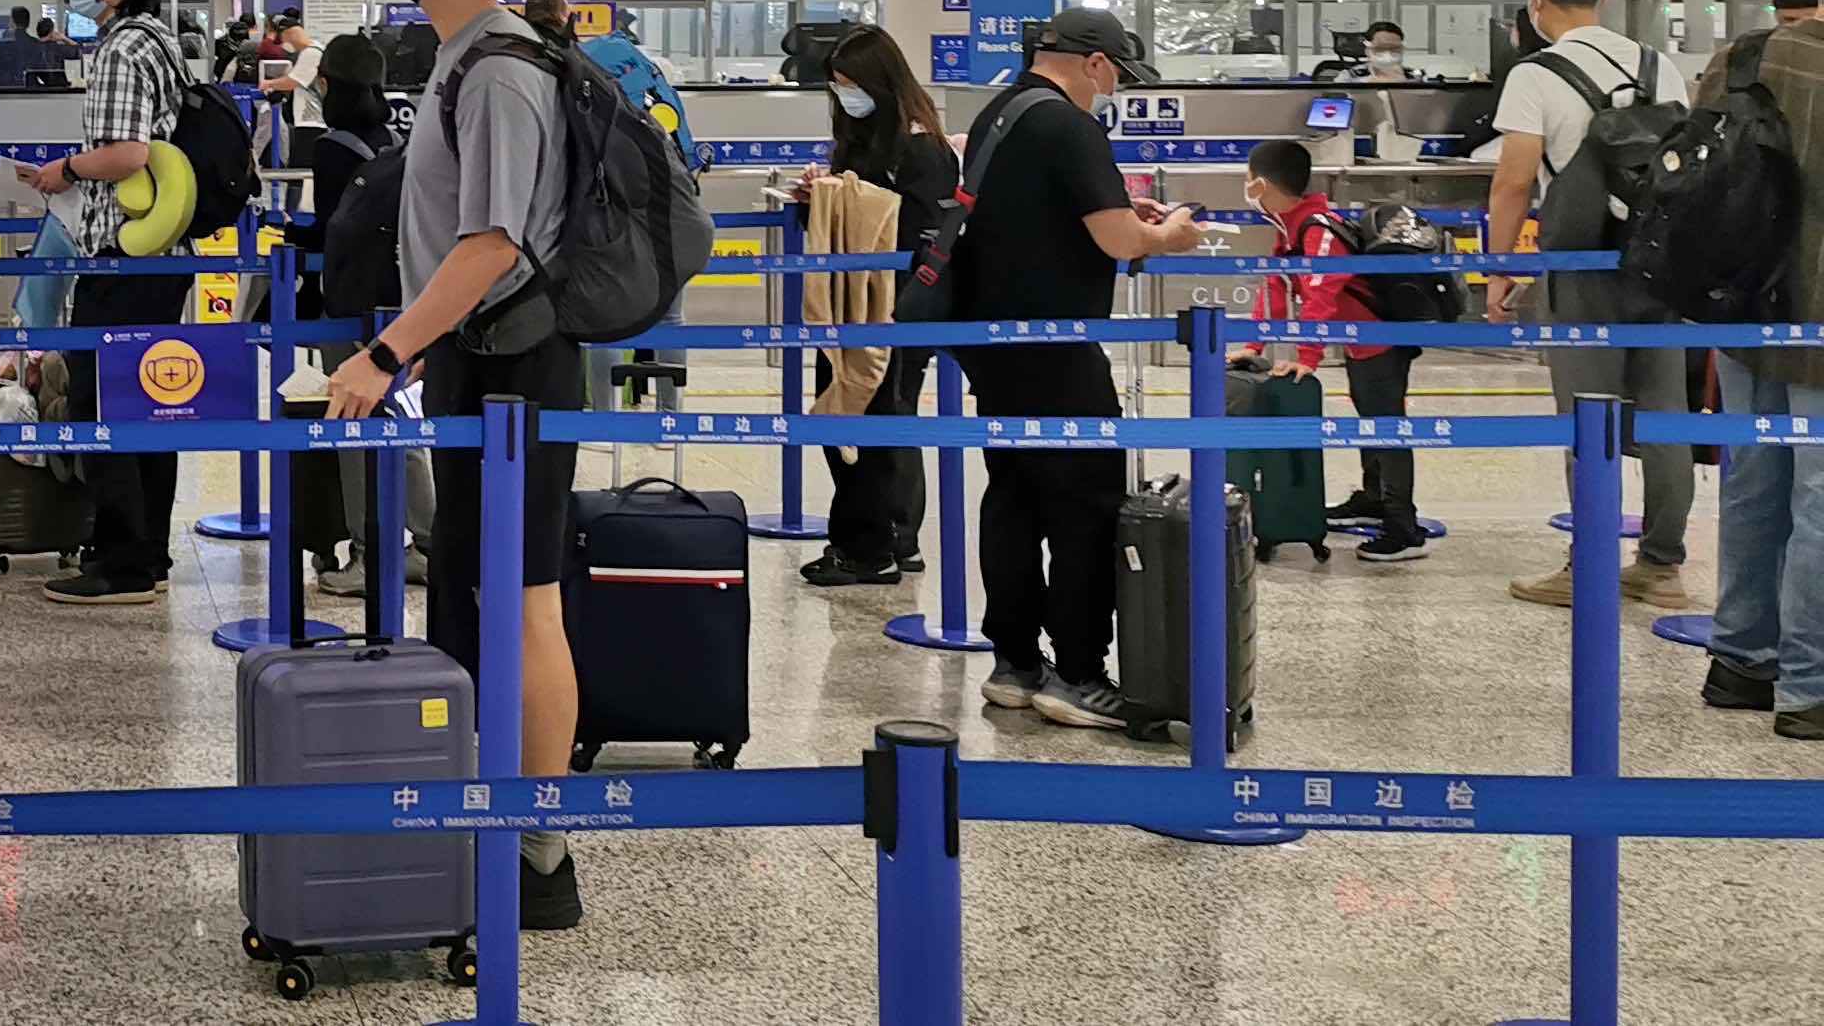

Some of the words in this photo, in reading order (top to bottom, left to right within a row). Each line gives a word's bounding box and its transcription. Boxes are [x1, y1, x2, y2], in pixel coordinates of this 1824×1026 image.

[308, 420, 437, 439] 中国边检
[661, 415, 789, 434] 中国边检
[392, 779, 633, 812] 中国边检
[1233, 775, 1475, 811] 中国边检
[392, 817, 437, 828] CHINA
[545, 814, 634, 826] INSPECTION
